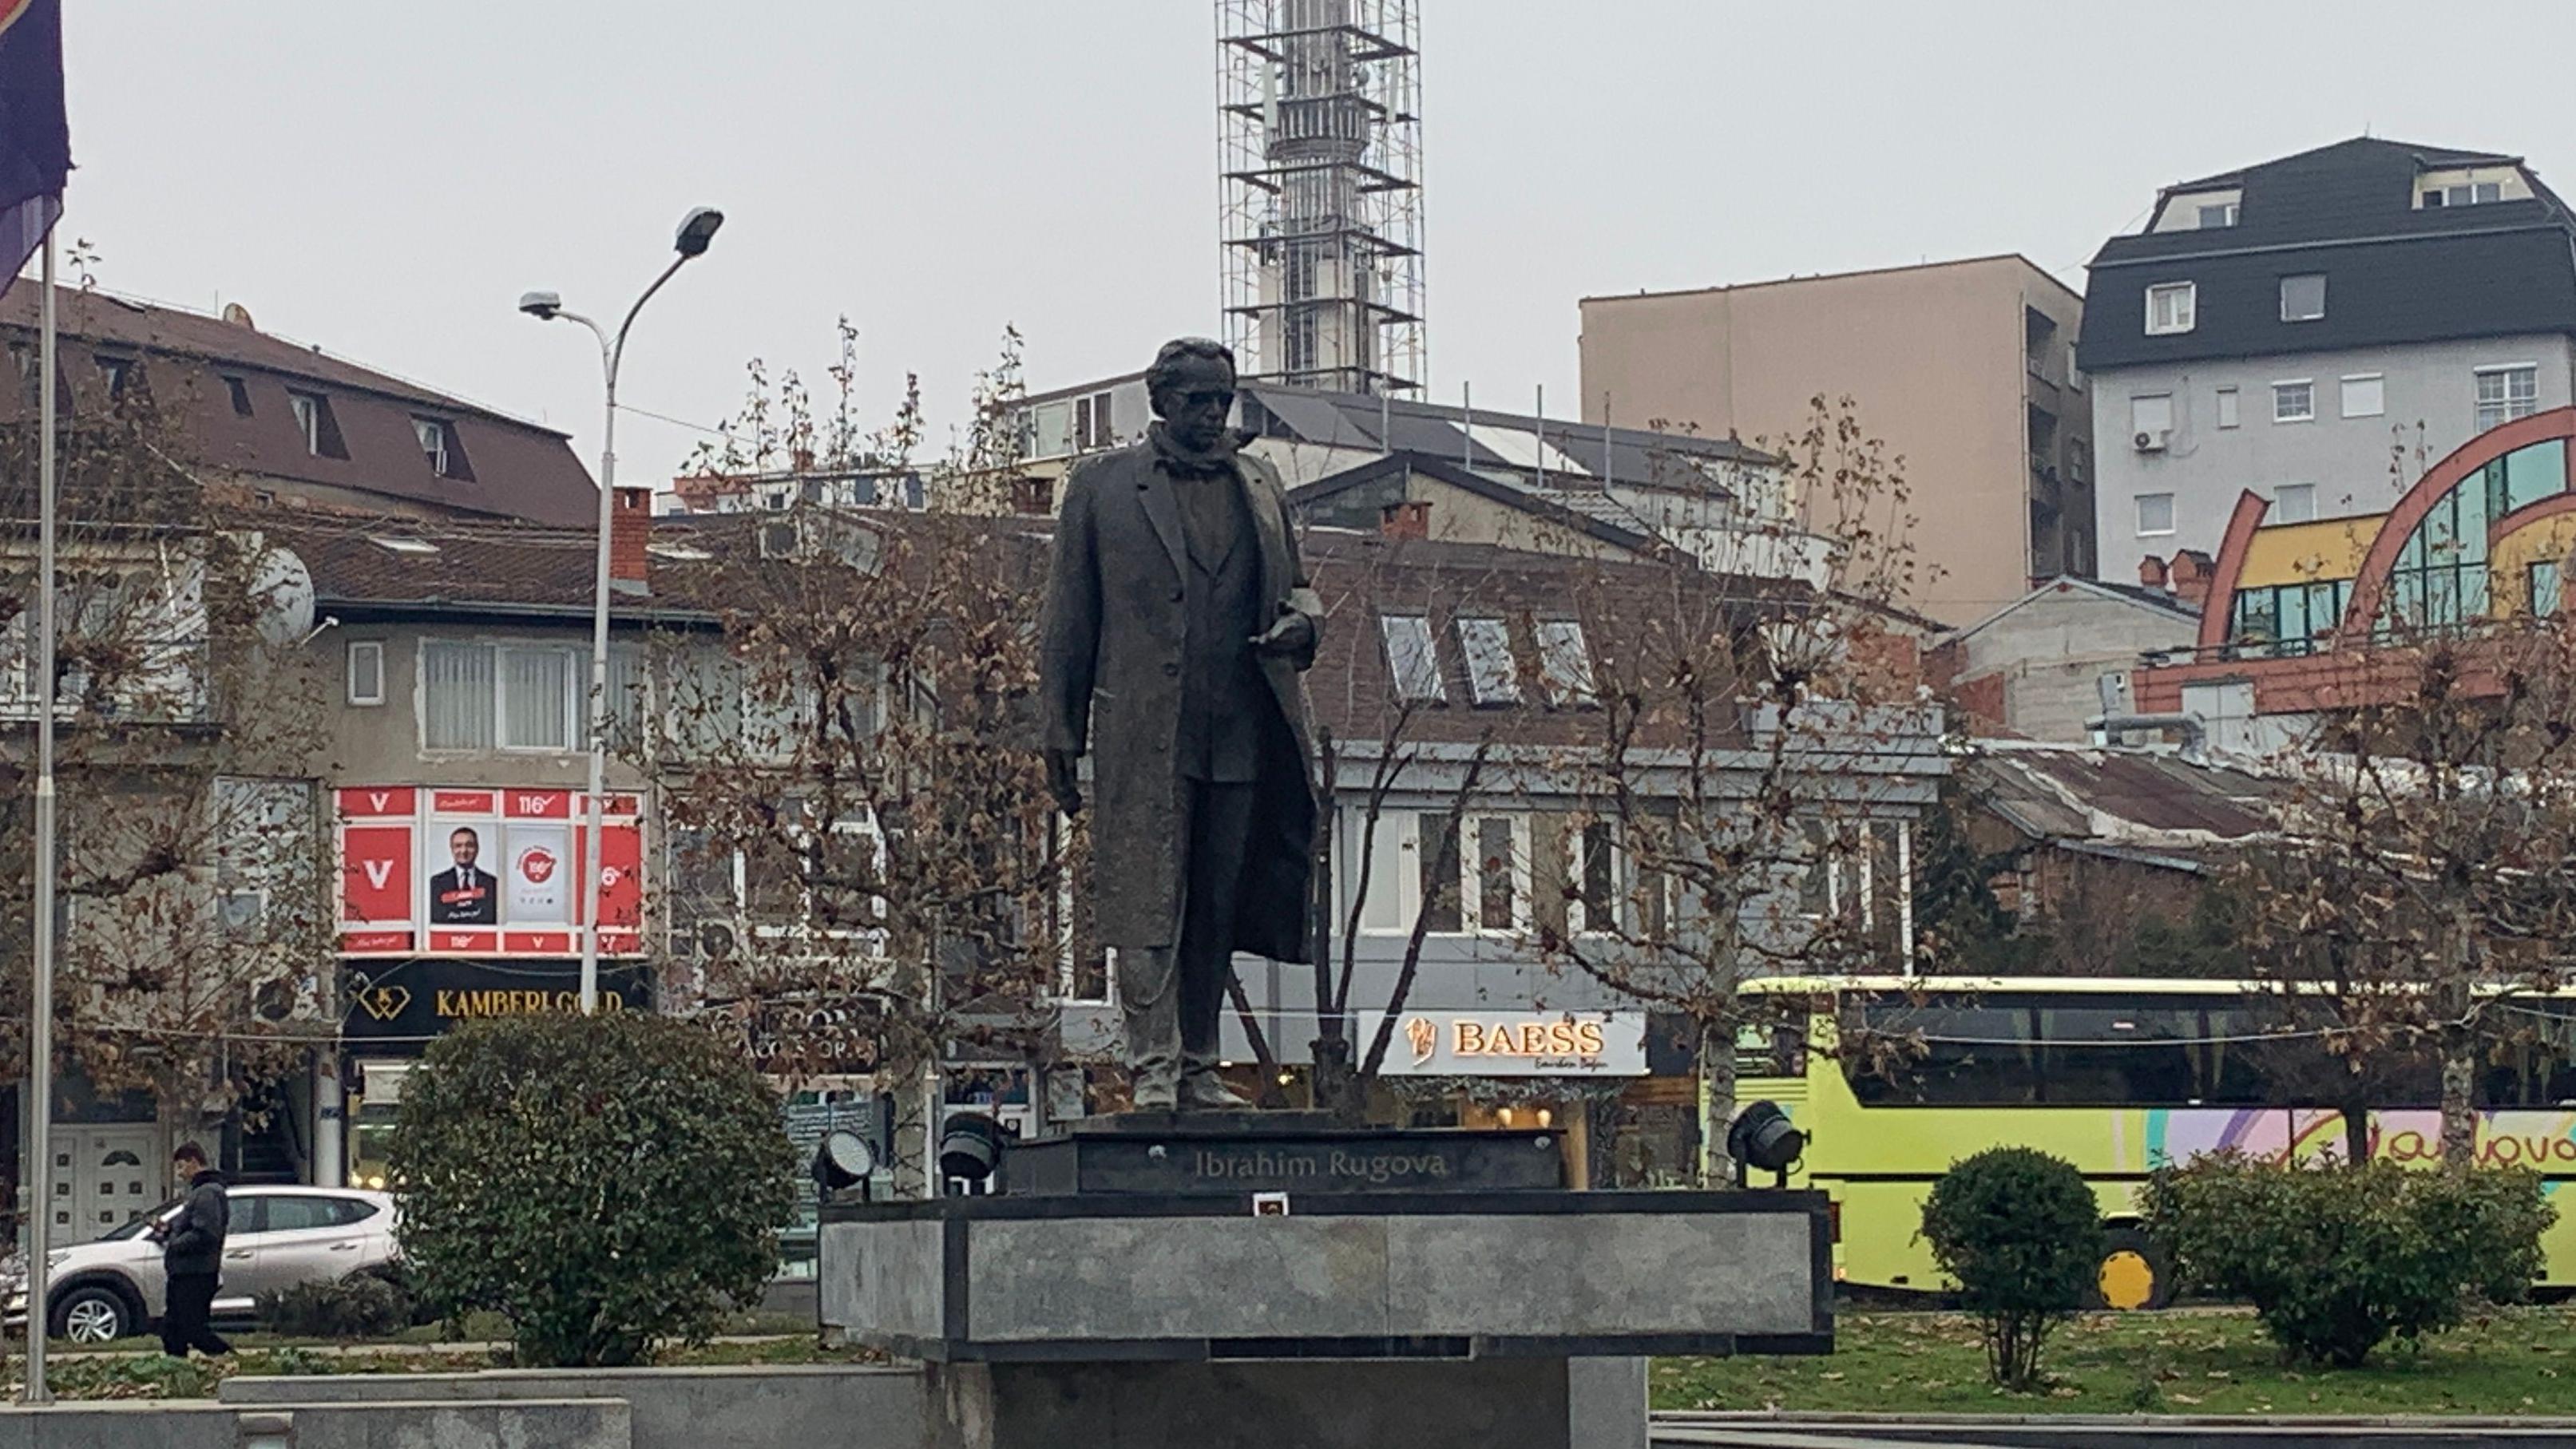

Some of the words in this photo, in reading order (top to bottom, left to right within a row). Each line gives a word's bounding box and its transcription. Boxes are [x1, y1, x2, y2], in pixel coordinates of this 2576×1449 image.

[369, 793, 389, 813] V
[519, 795, 549, 814] 116
[363, 860, 394, 890] V
[437, 990, 550, 1015] KAMBERI
[1454, 1022, 1605, 1055] BAESS
[1197, 1151, 1315, 1178] Ibrahim
[1330, 1150, 1449, 1182] Rugova
